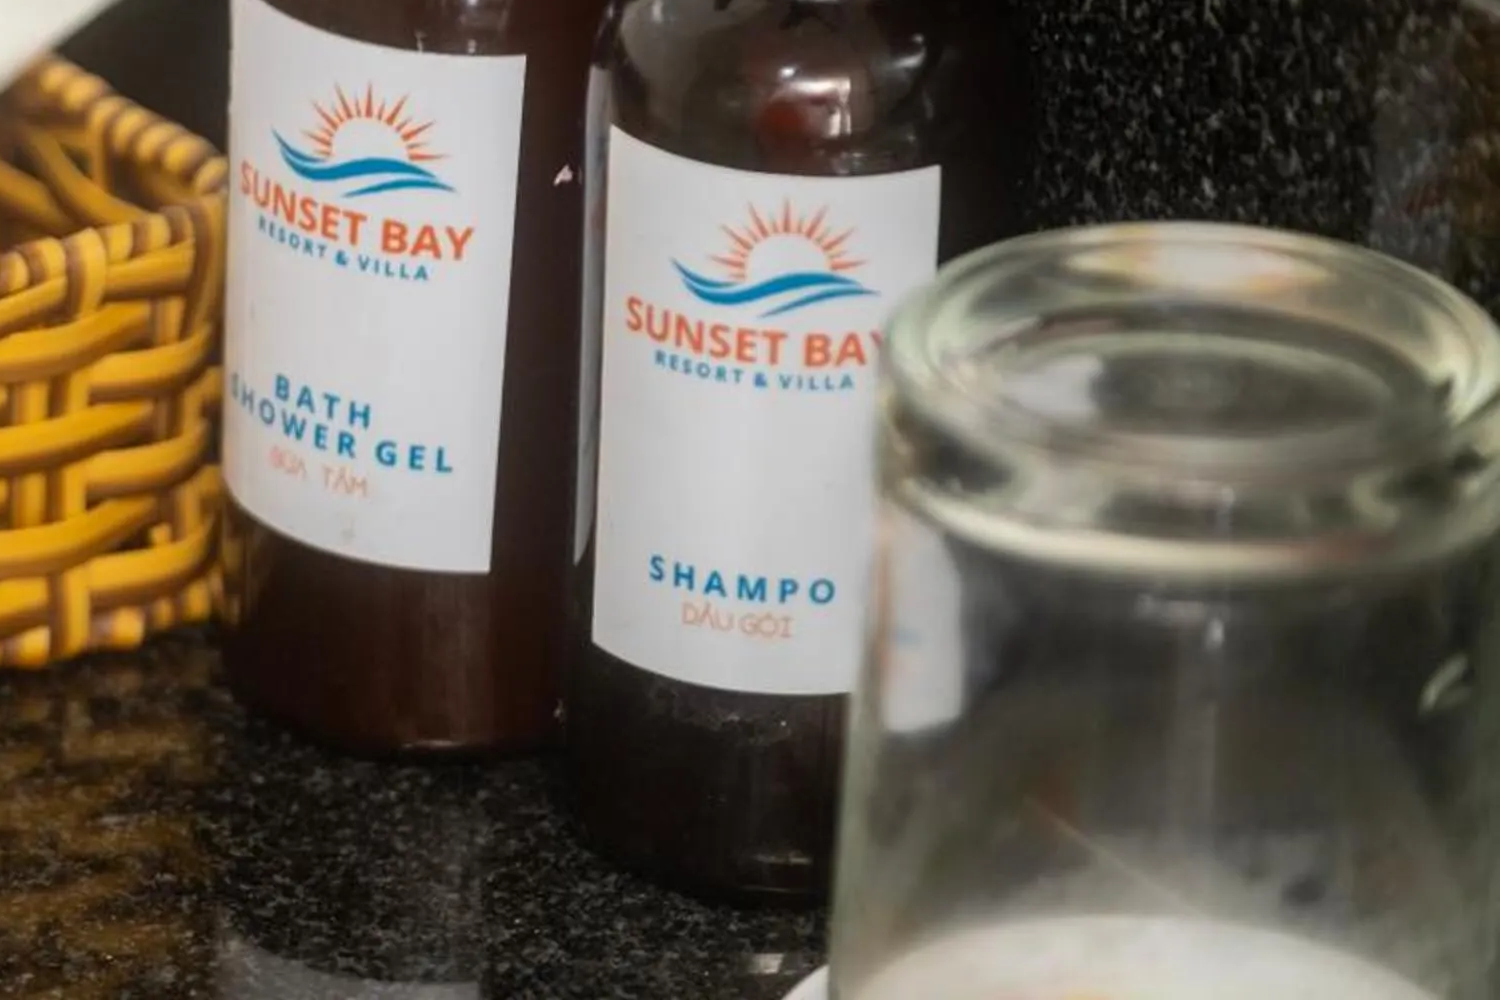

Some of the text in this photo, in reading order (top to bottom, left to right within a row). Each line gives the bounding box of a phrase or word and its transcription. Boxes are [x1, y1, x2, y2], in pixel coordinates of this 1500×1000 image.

[240, 159, 475, 261] SUNSET BAY
[258, 214, 430, 281] RESORT & VILLA
[625, 296, 788, 367] SUNSET
[275, 373, 372, 430] BATH
[655, 350, 855, 392] RESORT & VILLA
[231, 372, 357, 459] SHOWER
[375, 440, 453, 473] GEL
[649, 556, 836, 605] SHAMPO
